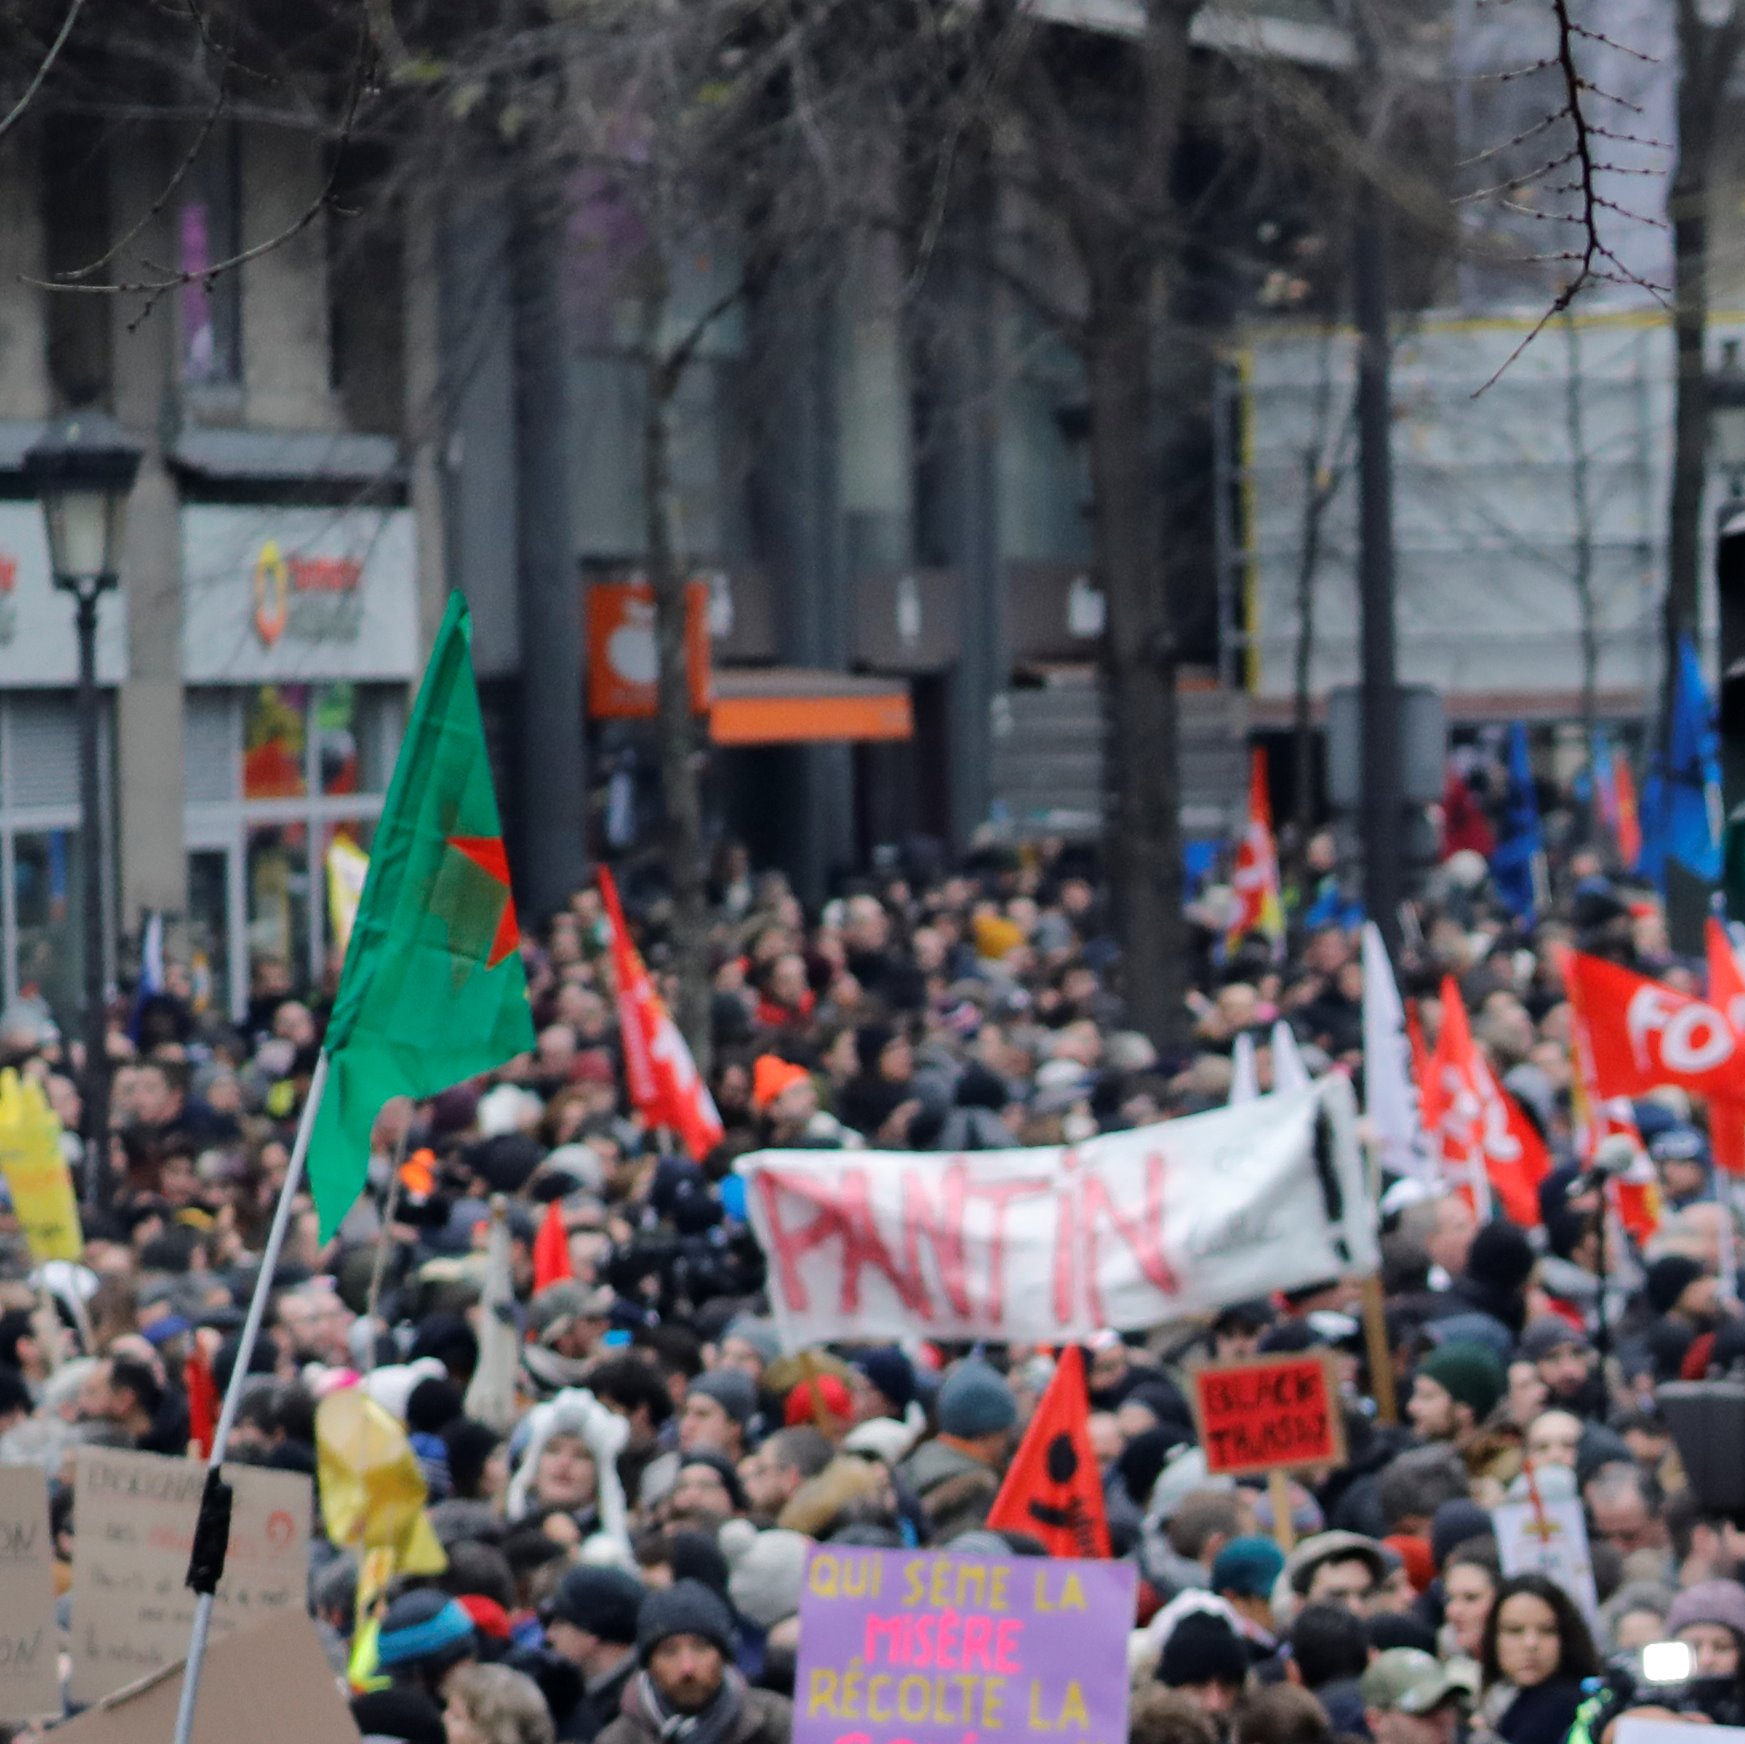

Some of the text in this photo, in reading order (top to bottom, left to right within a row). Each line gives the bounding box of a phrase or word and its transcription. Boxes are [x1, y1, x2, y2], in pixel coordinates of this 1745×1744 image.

[1034, 1571, 1088, 1612] LA
[808, 1656, 1090, 1730] RÉCOLTE LA
